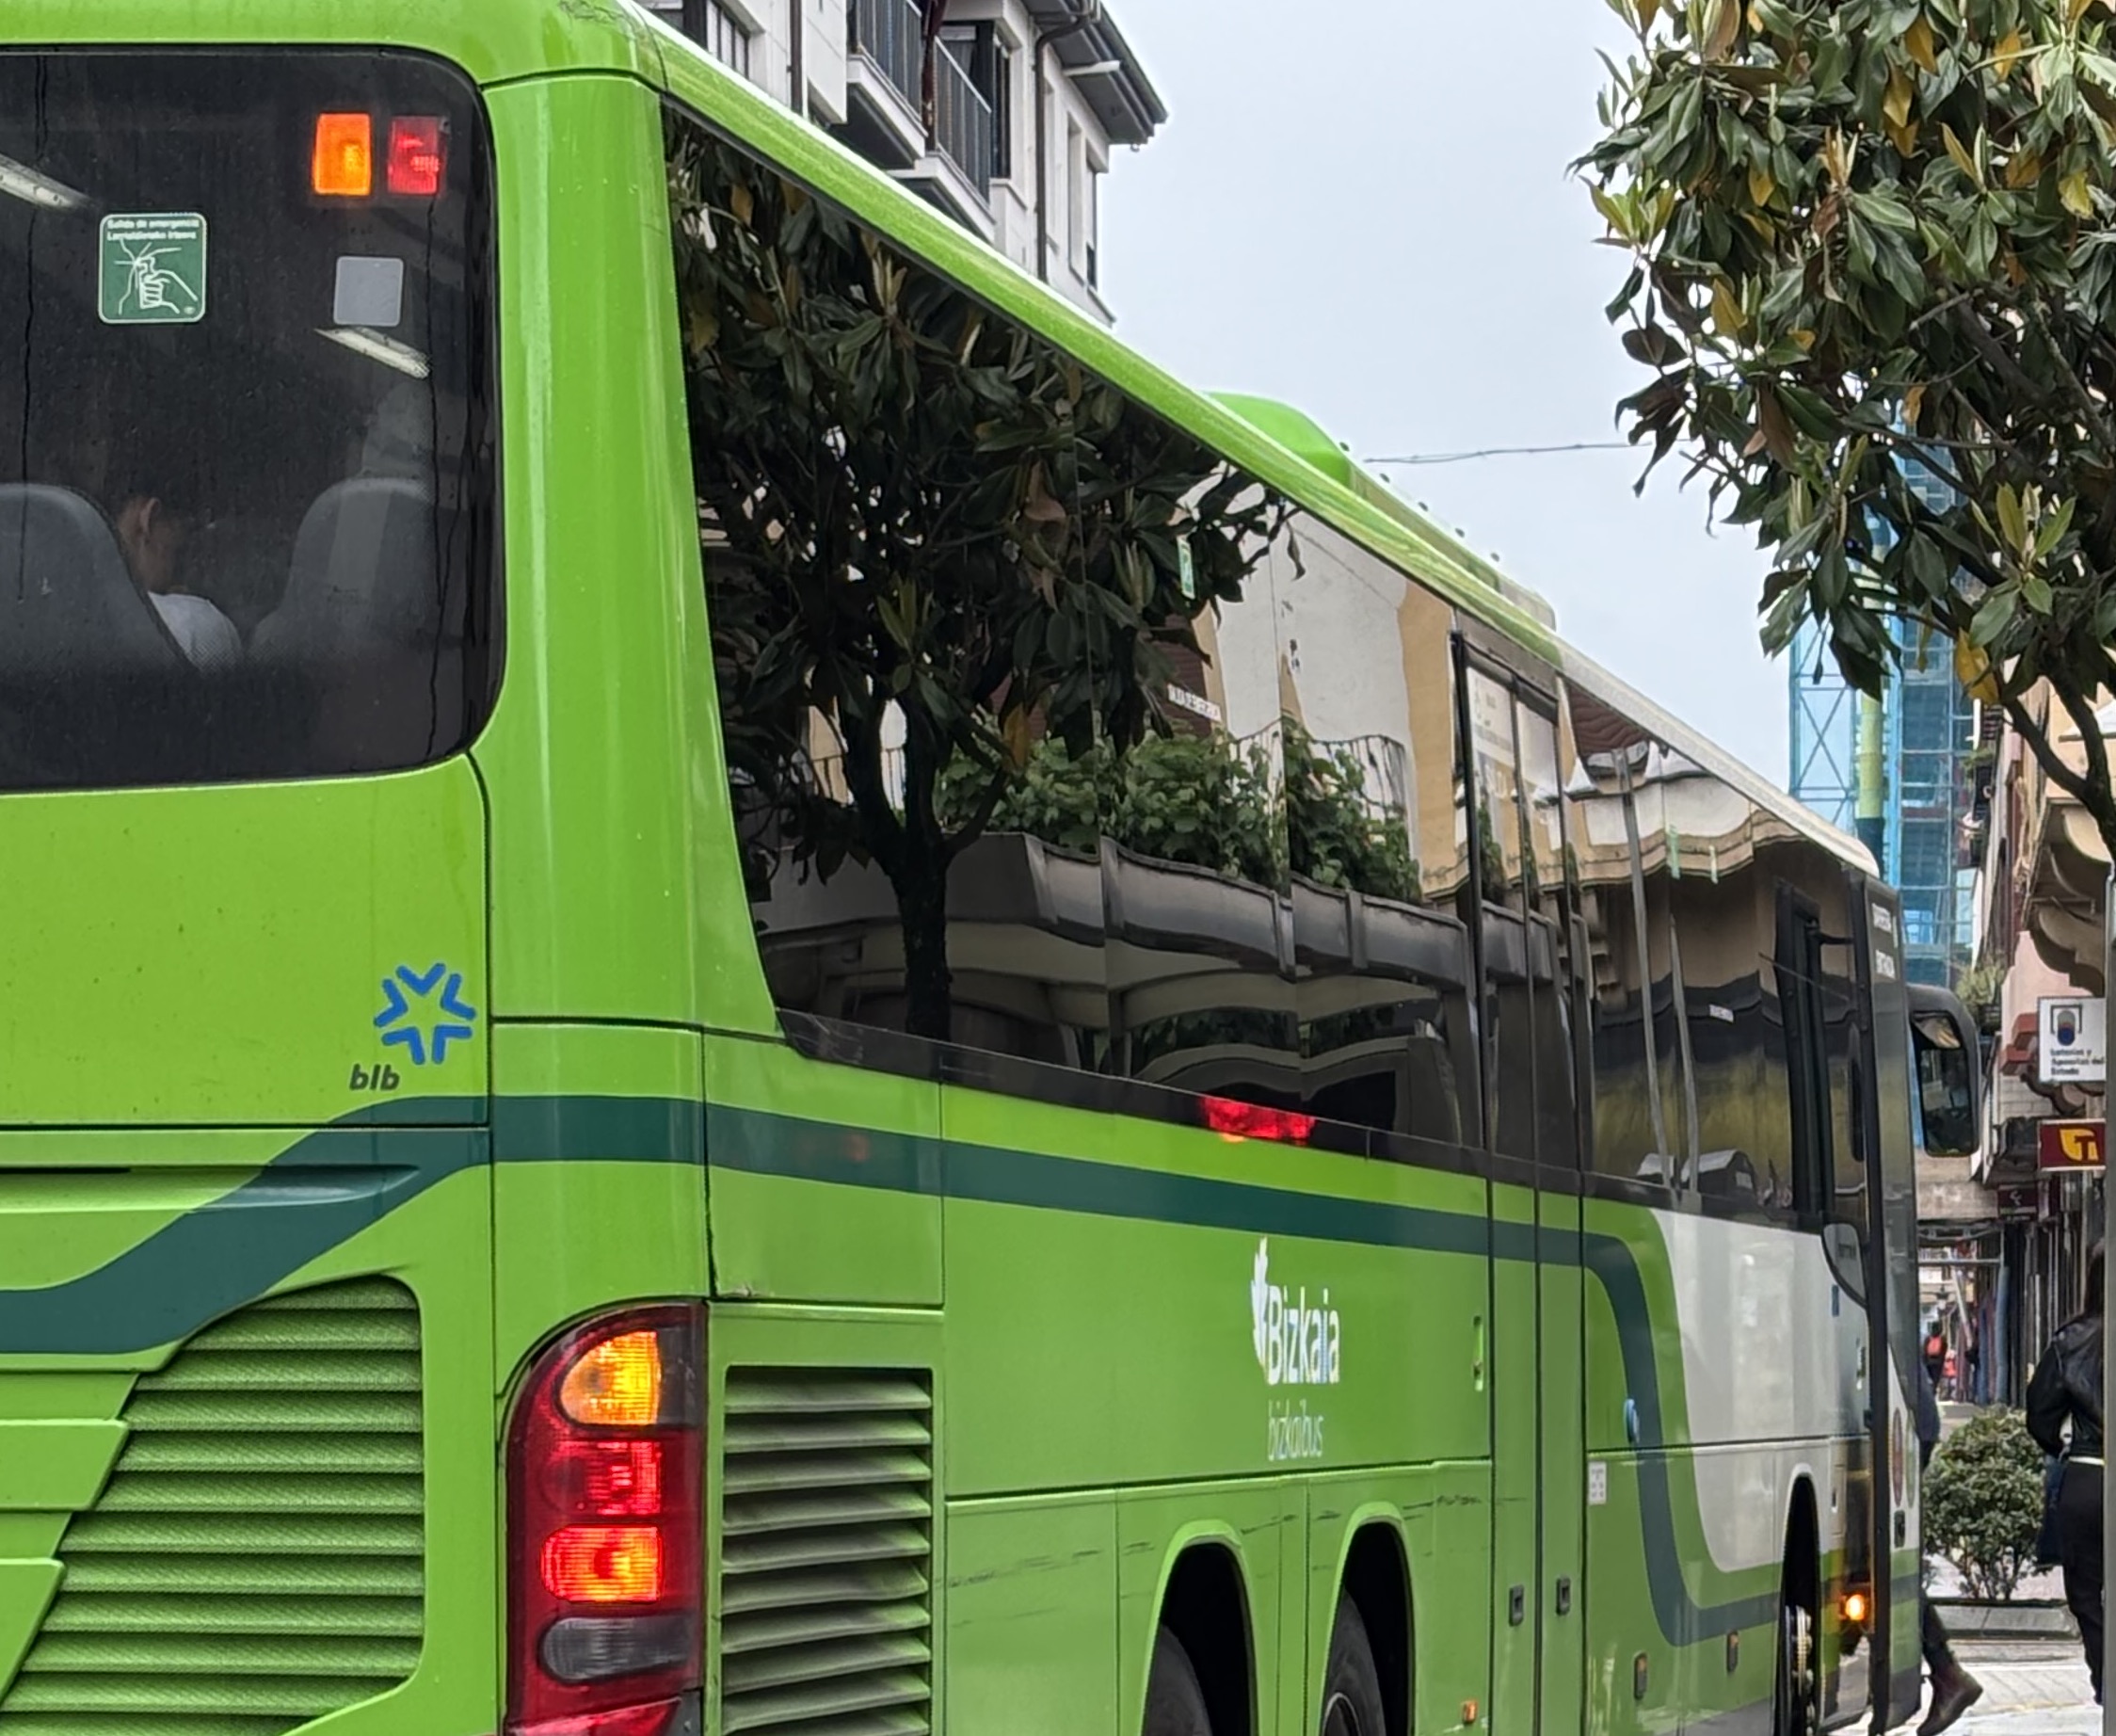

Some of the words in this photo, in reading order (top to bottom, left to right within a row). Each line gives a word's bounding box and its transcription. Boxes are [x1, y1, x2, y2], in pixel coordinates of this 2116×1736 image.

[349, 1063, 400, 1091] blb
[1268, 1284, 1340, 1386] Bizkaia
[1268, 1399, 1324, 1462] bizkaibus
